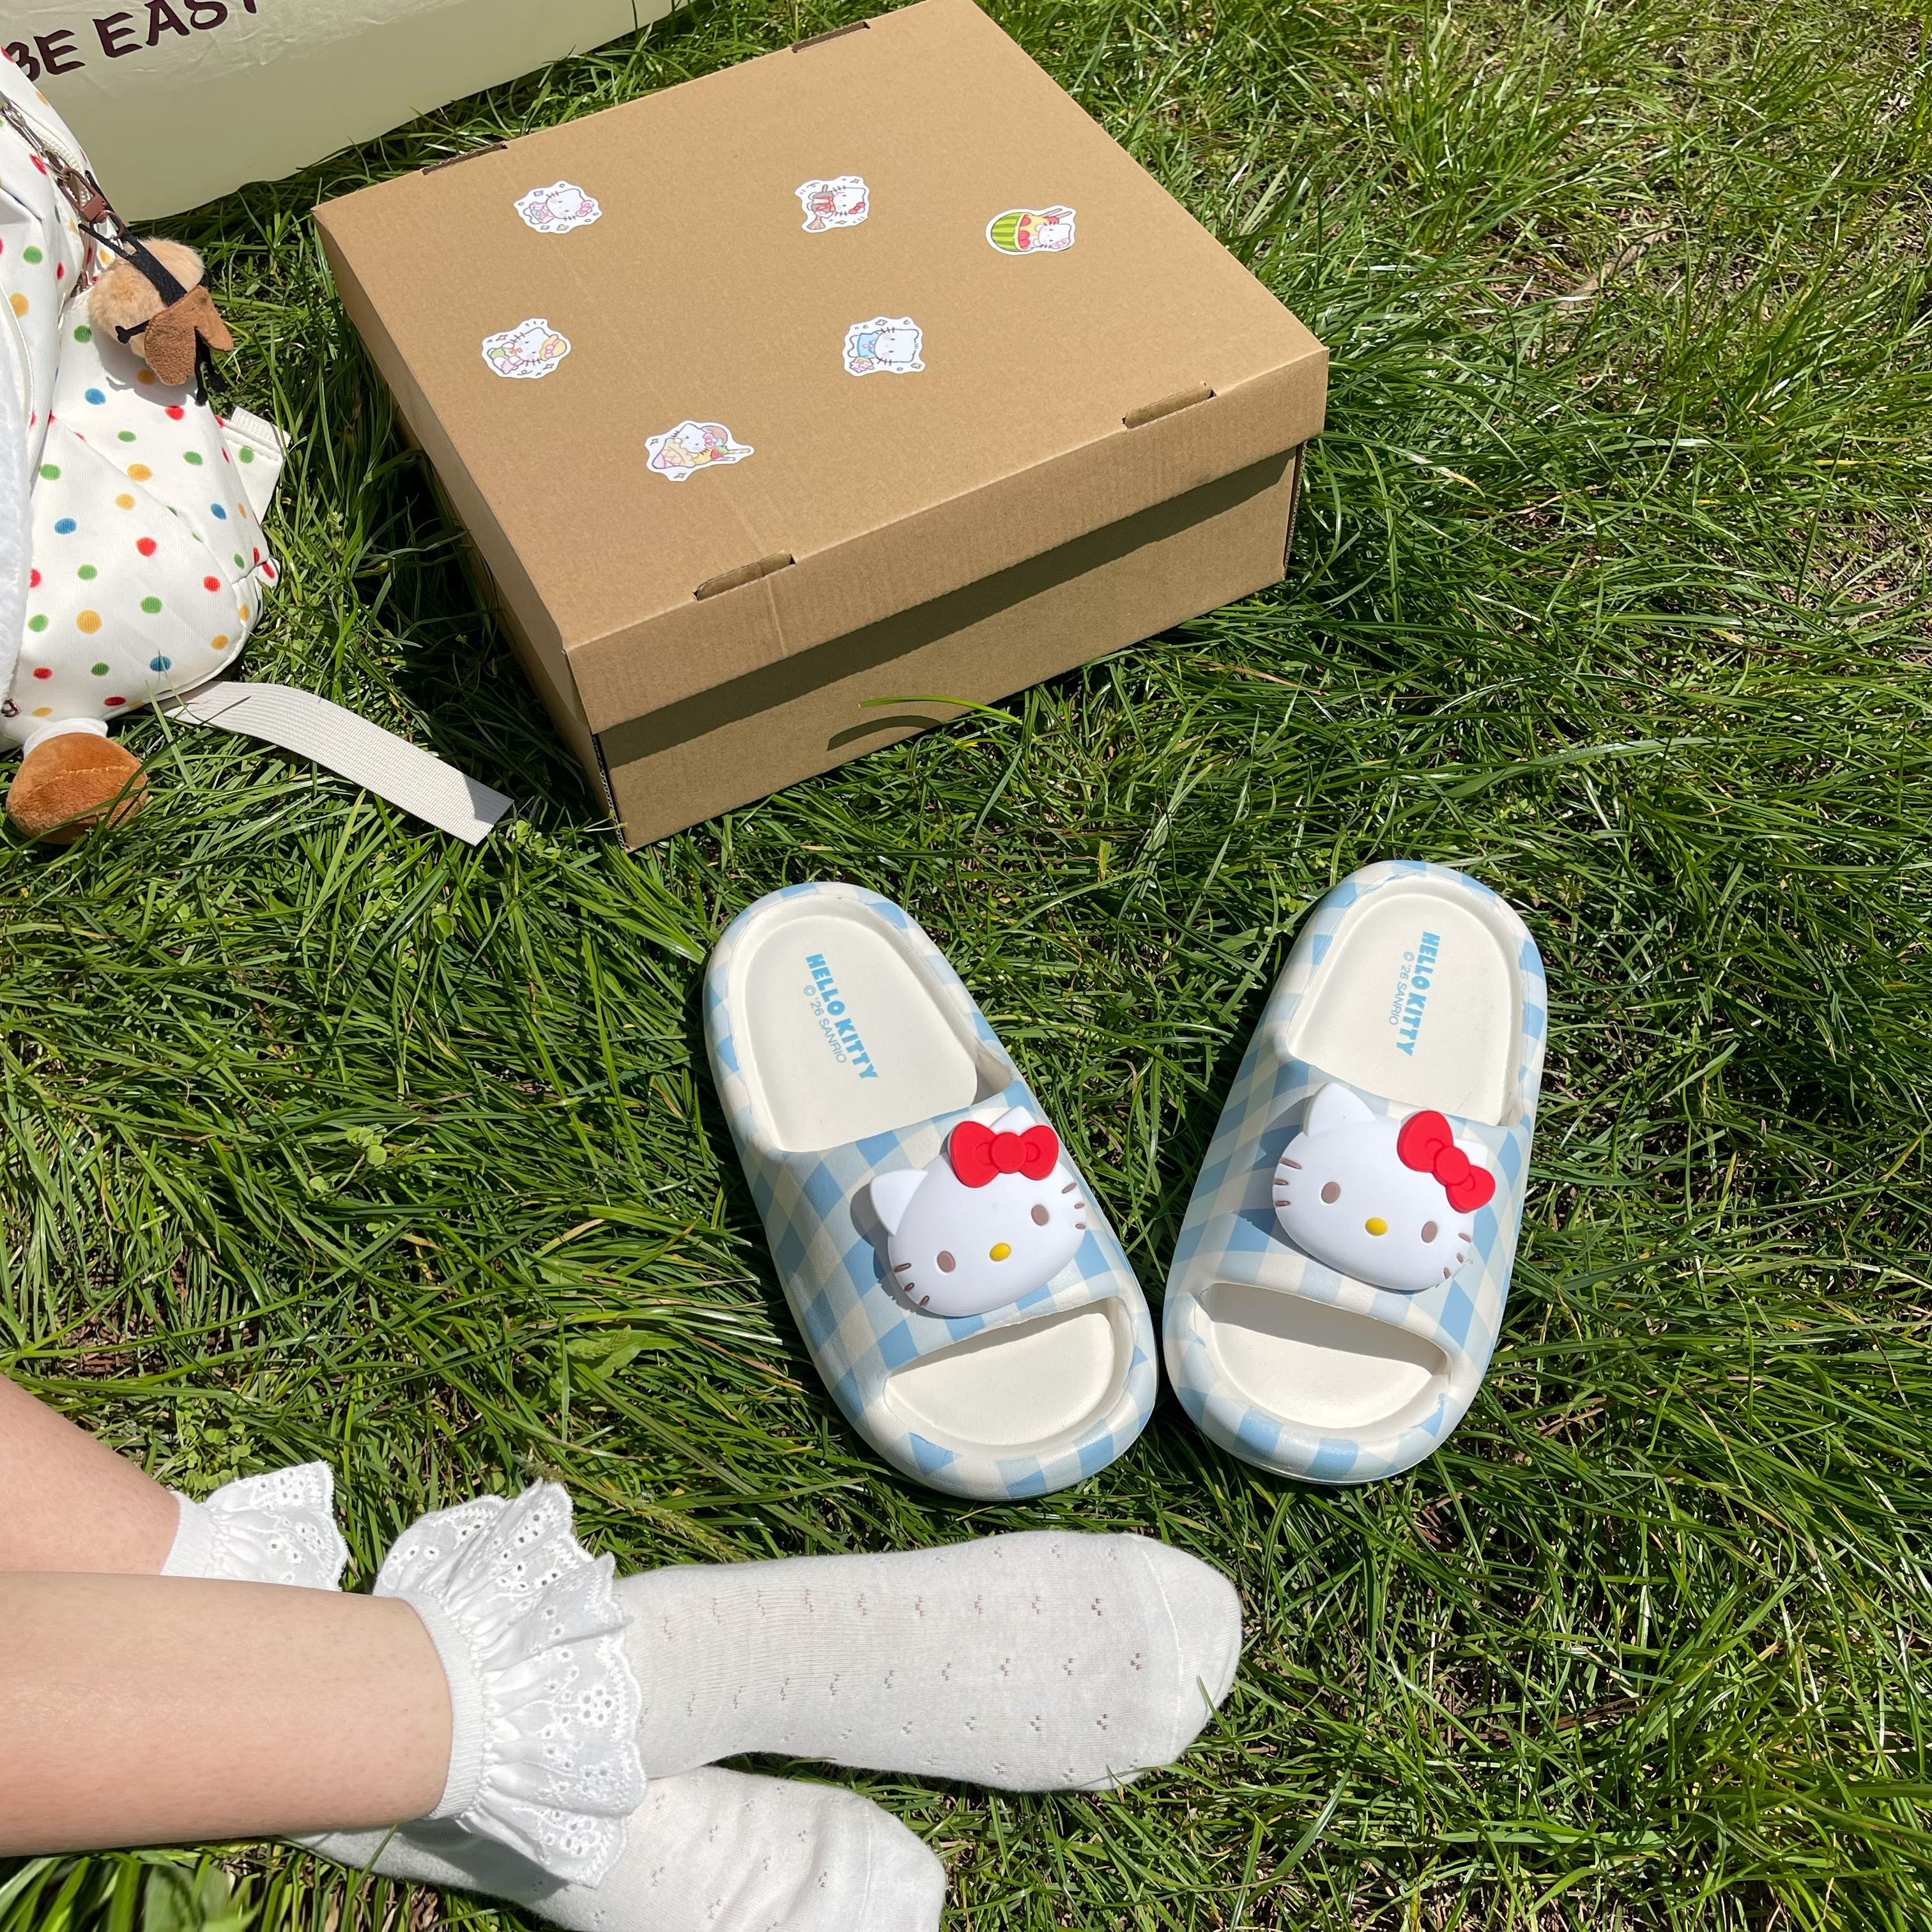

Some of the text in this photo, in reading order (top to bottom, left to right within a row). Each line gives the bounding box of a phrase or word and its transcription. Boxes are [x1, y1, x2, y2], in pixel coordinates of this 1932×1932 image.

[6, 29, 86, 82] BE
[805, 953, 878, 1079] HELLO KITTY
[1388, 981, 1407, 1025] SANRIO
[1395, 931, 1441, 1057] HELLO KITTY
[818, 1018, 847, 1063] SANRIO
